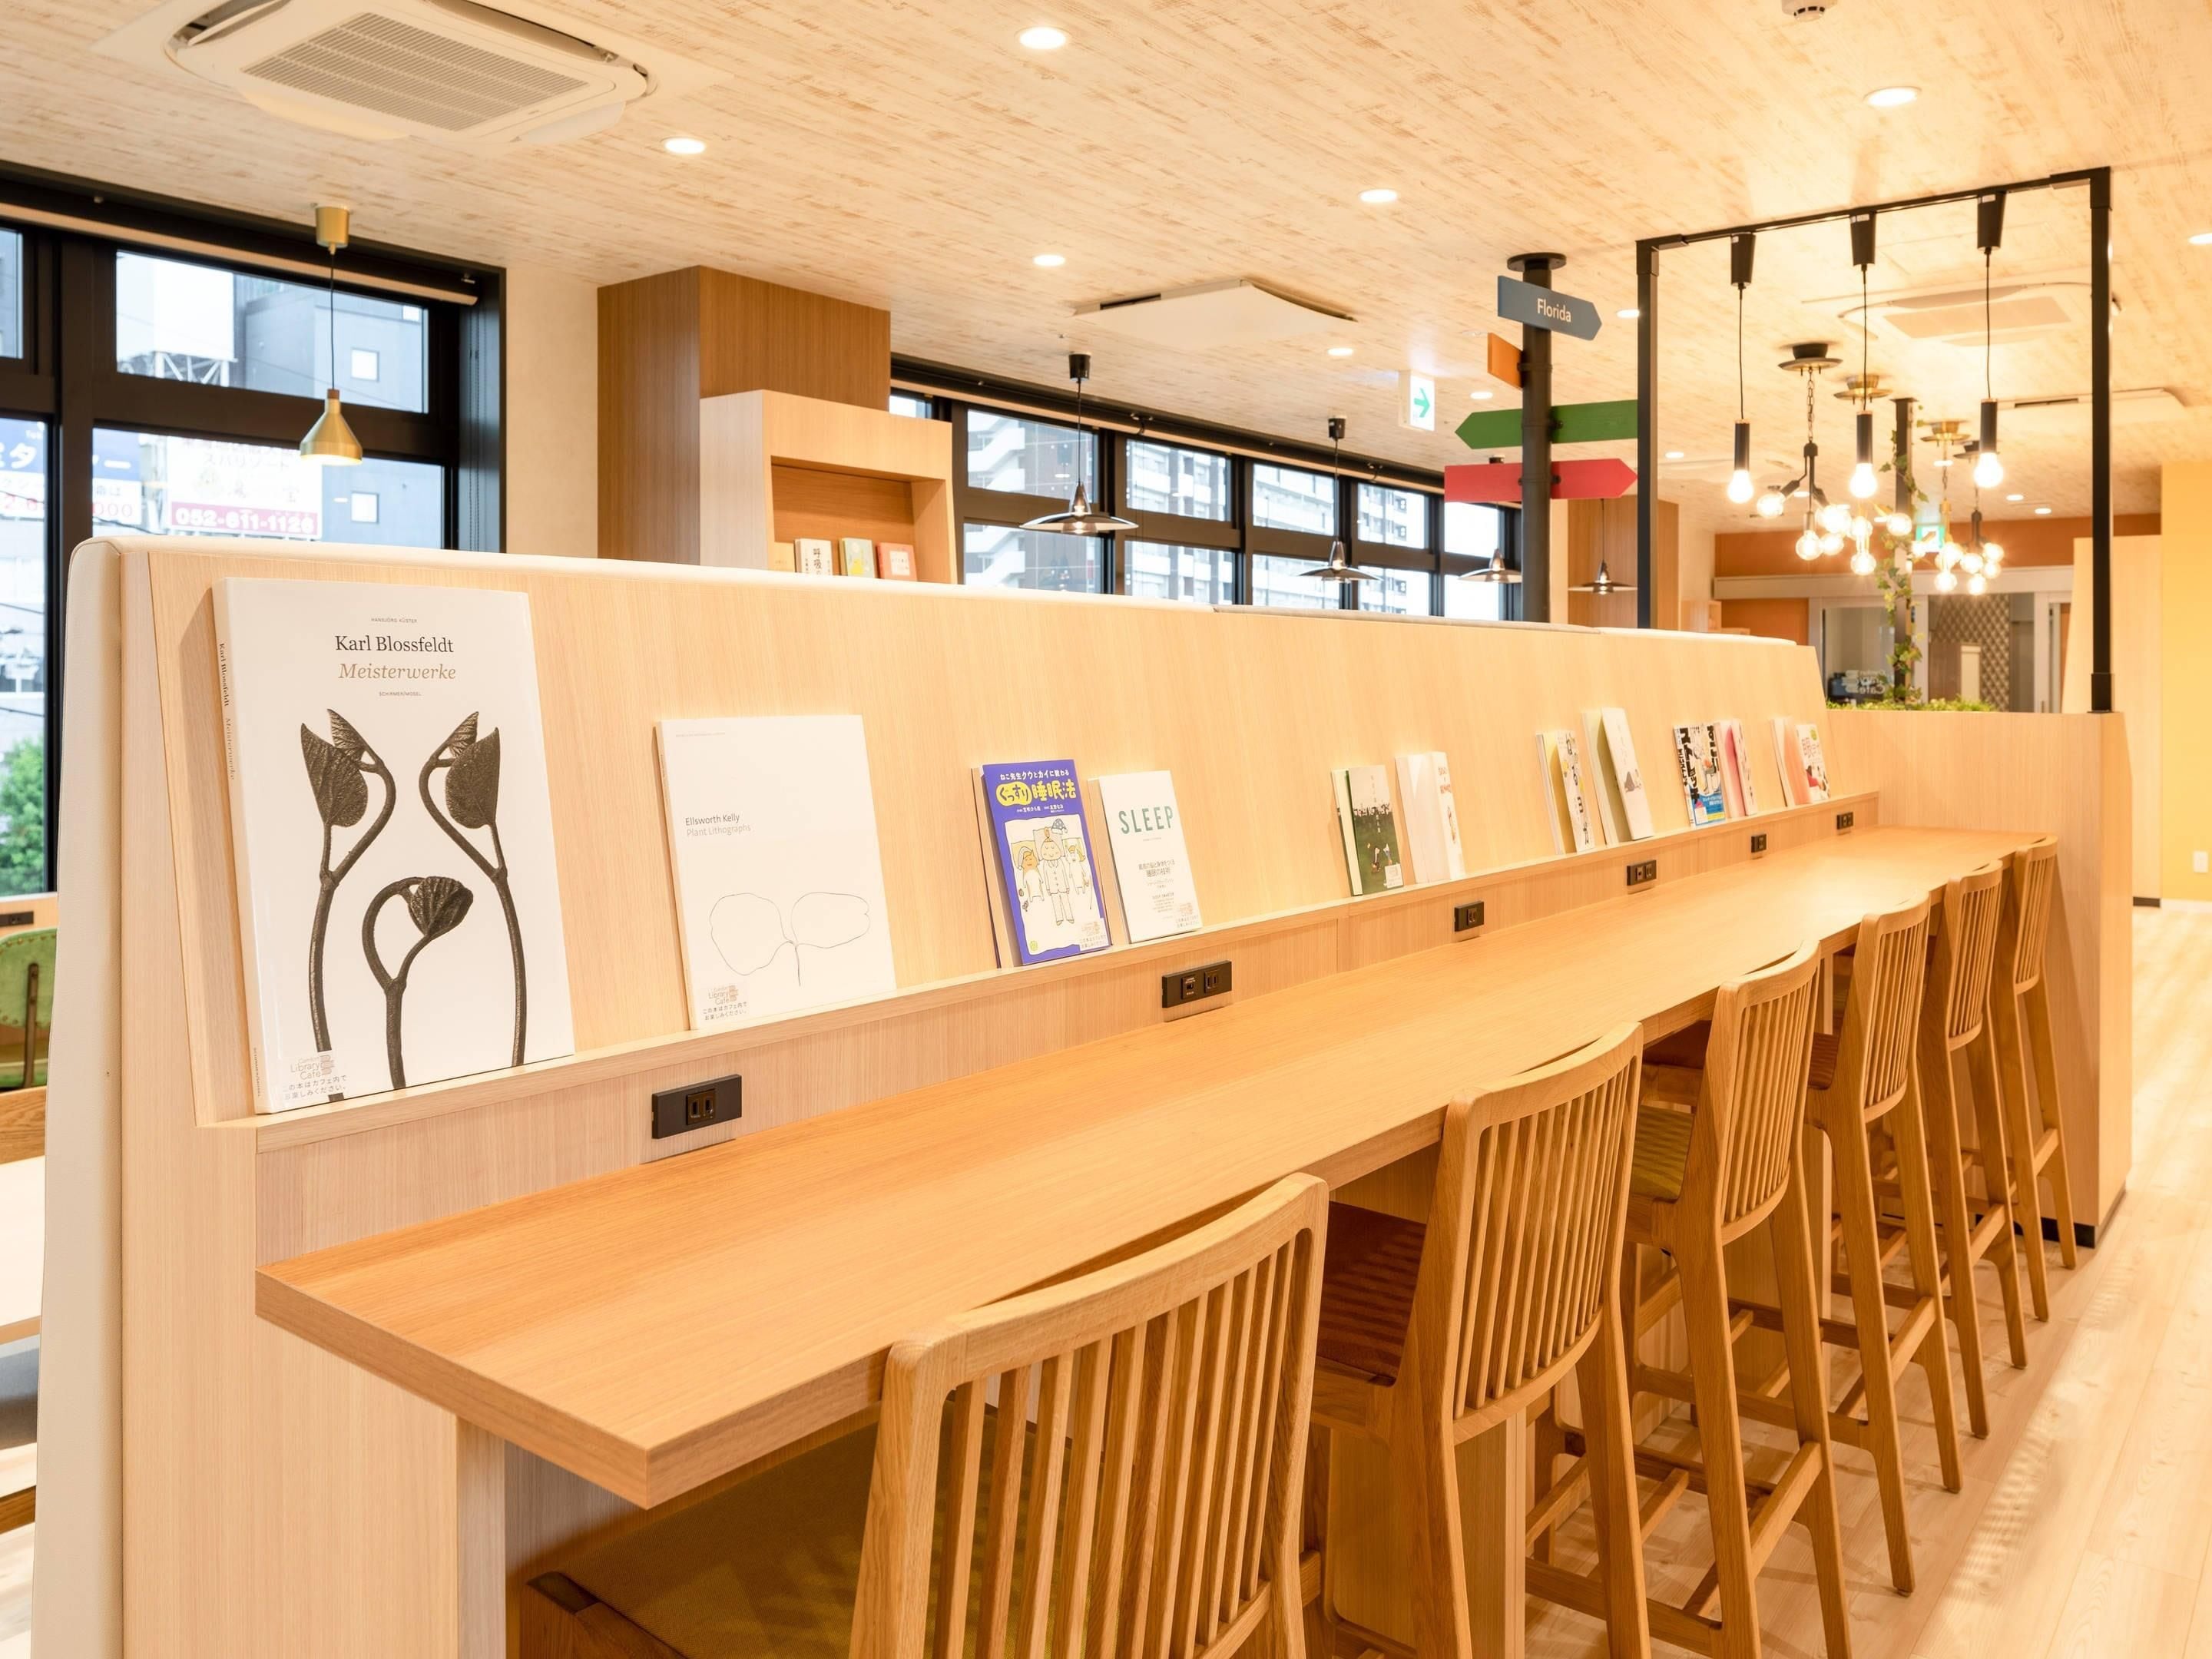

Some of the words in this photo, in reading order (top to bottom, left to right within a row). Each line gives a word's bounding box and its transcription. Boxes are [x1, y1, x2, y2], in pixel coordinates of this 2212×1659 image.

[1537, 297, 1571, 323] Florida
[176, 507, 315, 534] 052-611-1126
[334, 634, 372, 651] Karl
[376, 635, 455, 653] Blossfeldt
[337, 663, 456, 680] Meisterwerke
[220, 663, 230, 707] Blossfeldt
[999, 769, 1070, 781] ねこ先生クウとカイに教わる
[685, 813, 720, 826] Ellsworth
[722, 813, 740, 824] Kelly
[1118, 805, 1174, 835] SLEEP
[686, 826, 707, 837] Plant
[708, 823, 752, 836] Lithographs
[707, 990, 730, 999] Library
[290, 1061, 321, 1074] Library
[300, 1069, 321, 1081] Cafe
[282, 1075, 348, 1092] この本はカフェ内で
